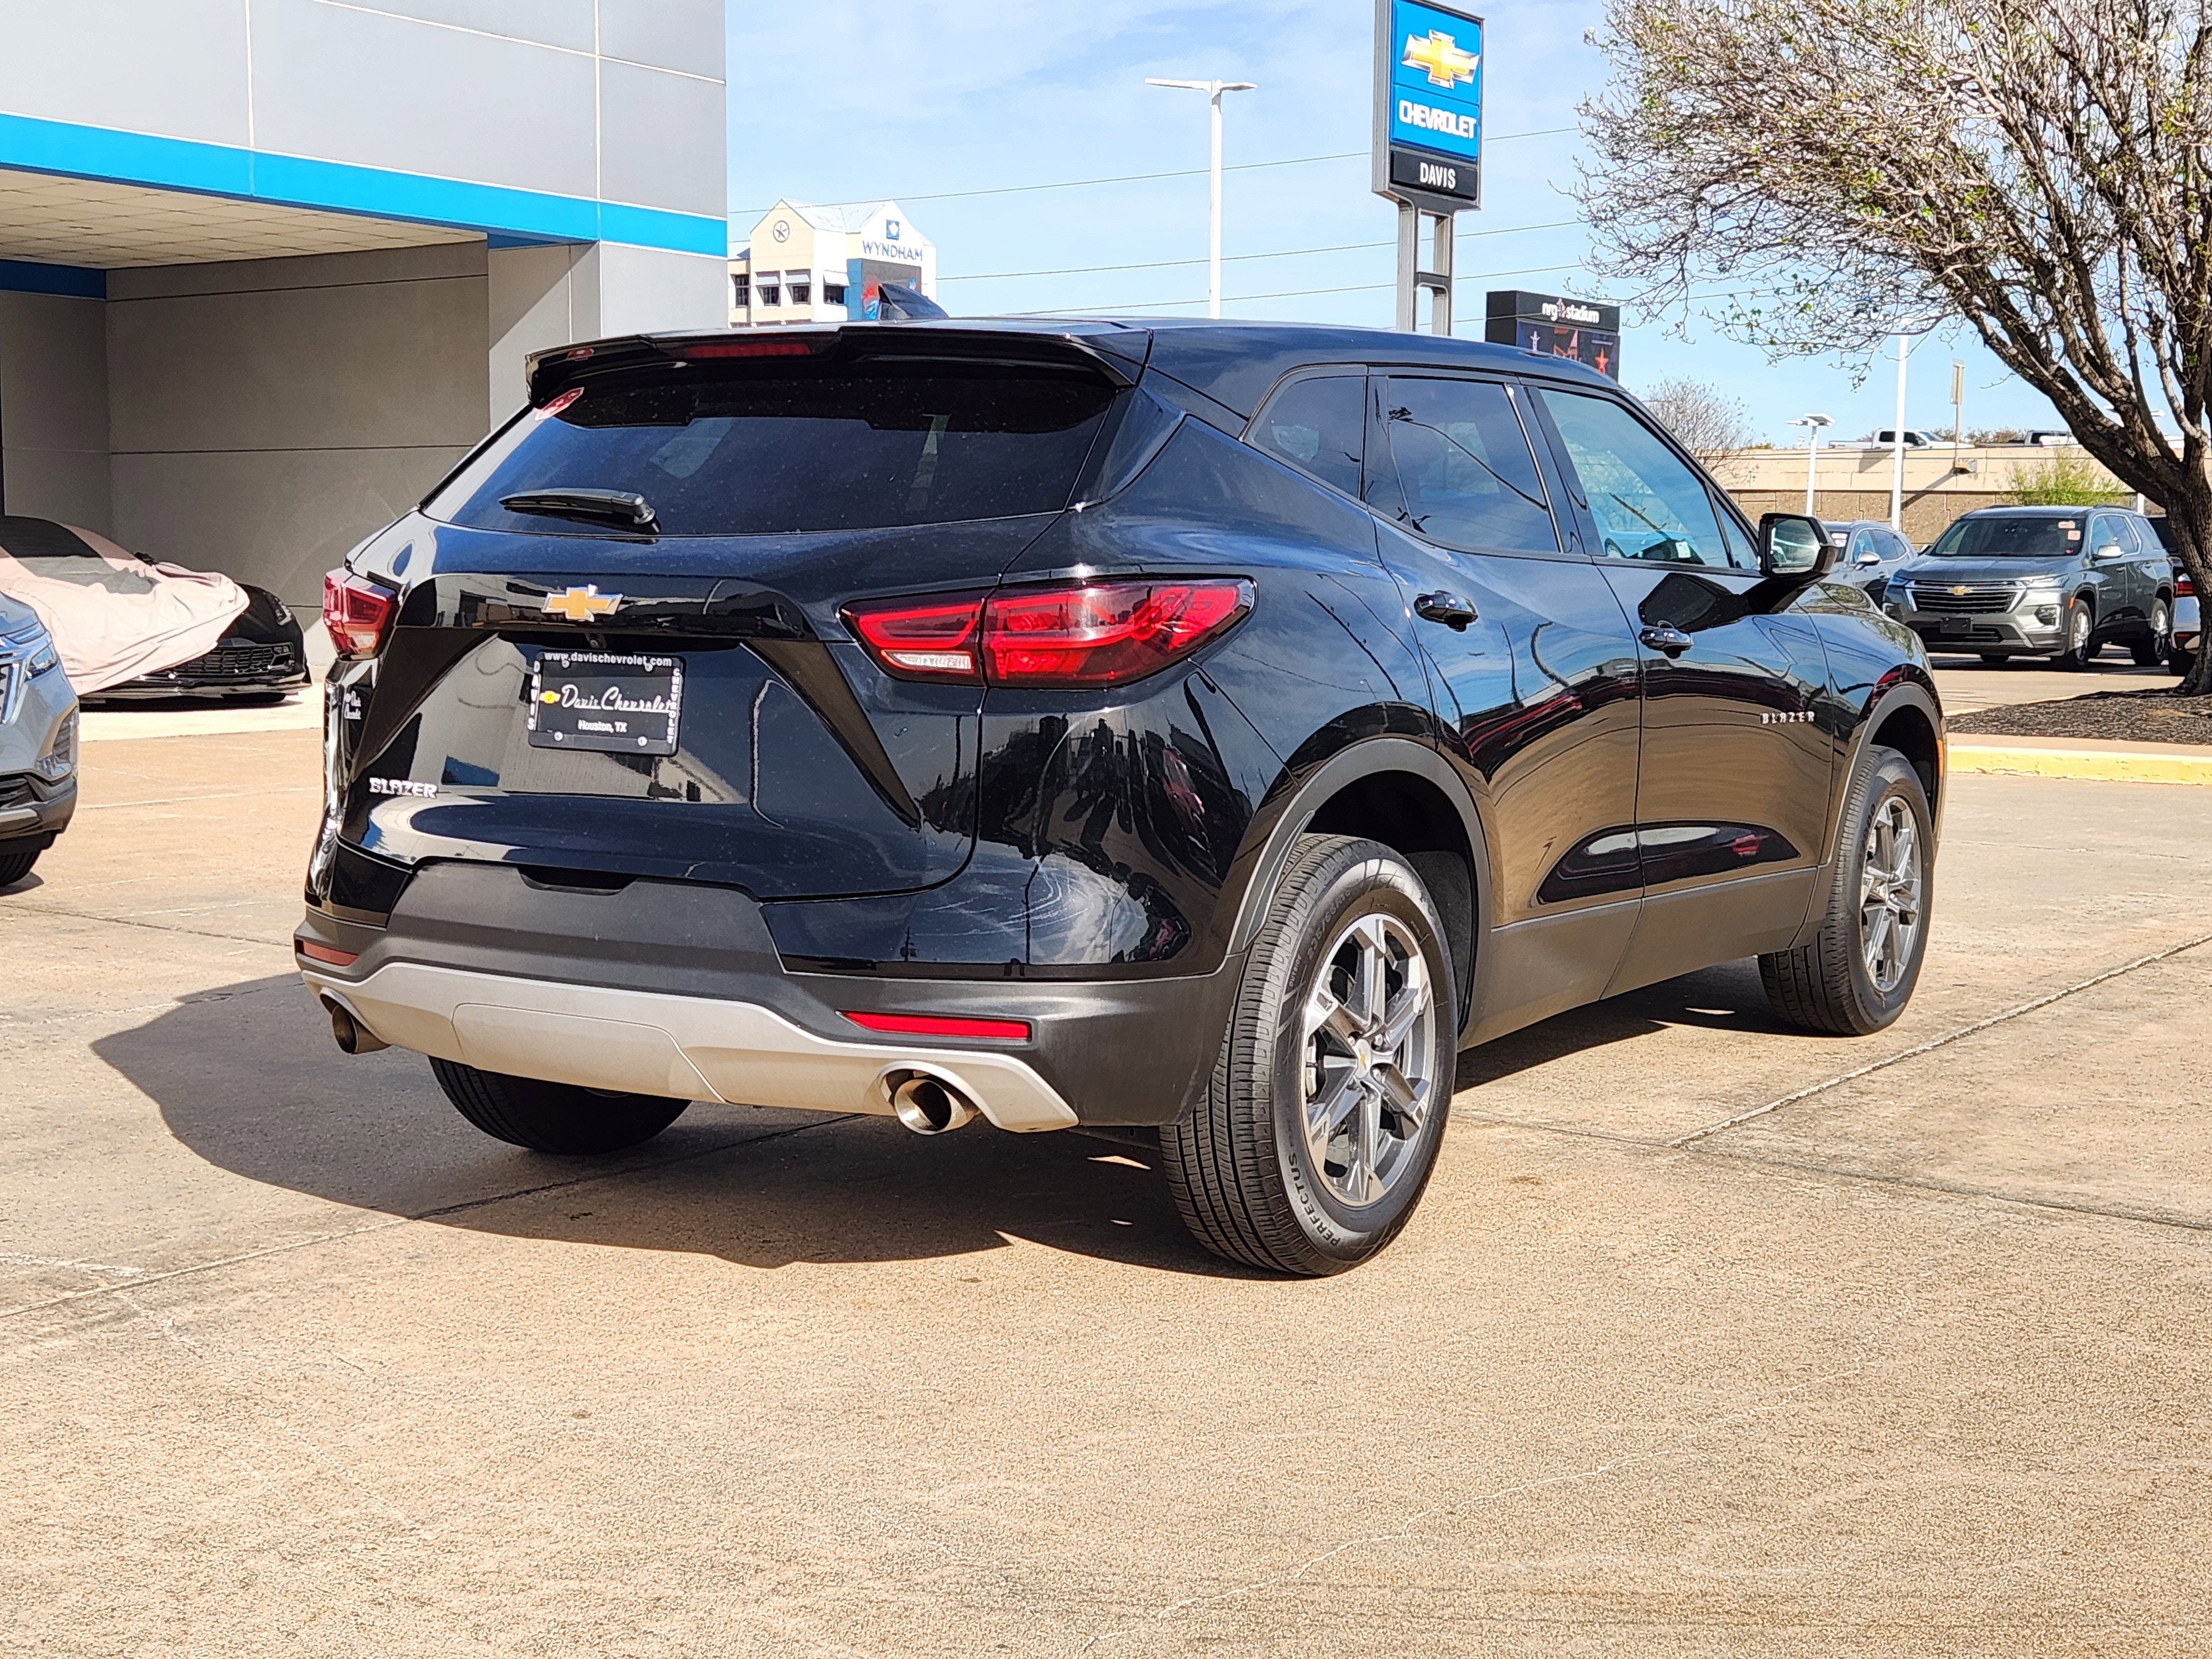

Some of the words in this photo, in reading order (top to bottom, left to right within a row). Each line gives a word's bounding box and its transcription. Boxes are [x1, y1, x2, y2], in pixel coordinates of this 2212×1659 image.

[1399, 100, 1477, 138] CHEVROLET
[1420, 162, 1456, 189] DAVIS
[863, 240, 922, 261] WYNDHAM
[1542, 302, 1557, 321] nrg
[1565, 304, 1600, 324] stadium
[544, 652, 672, 667] www.davischevrolet.com
[527, 660, 540, 730] DAVIS
[561, 684, 601, 709] Davis
[601, 686, 672, 713] Chevrolet
[666, 667, 681, 744] CHEVROLET
[578, 719, 614, 733] Houston,
[614, 721, 628, 733] TX
[1760, 711, 1815, 724] BLAZER
[369, 777, 437, 799] BLAZER
[1288, 1152, 1341, 1246] PERFECTUS
